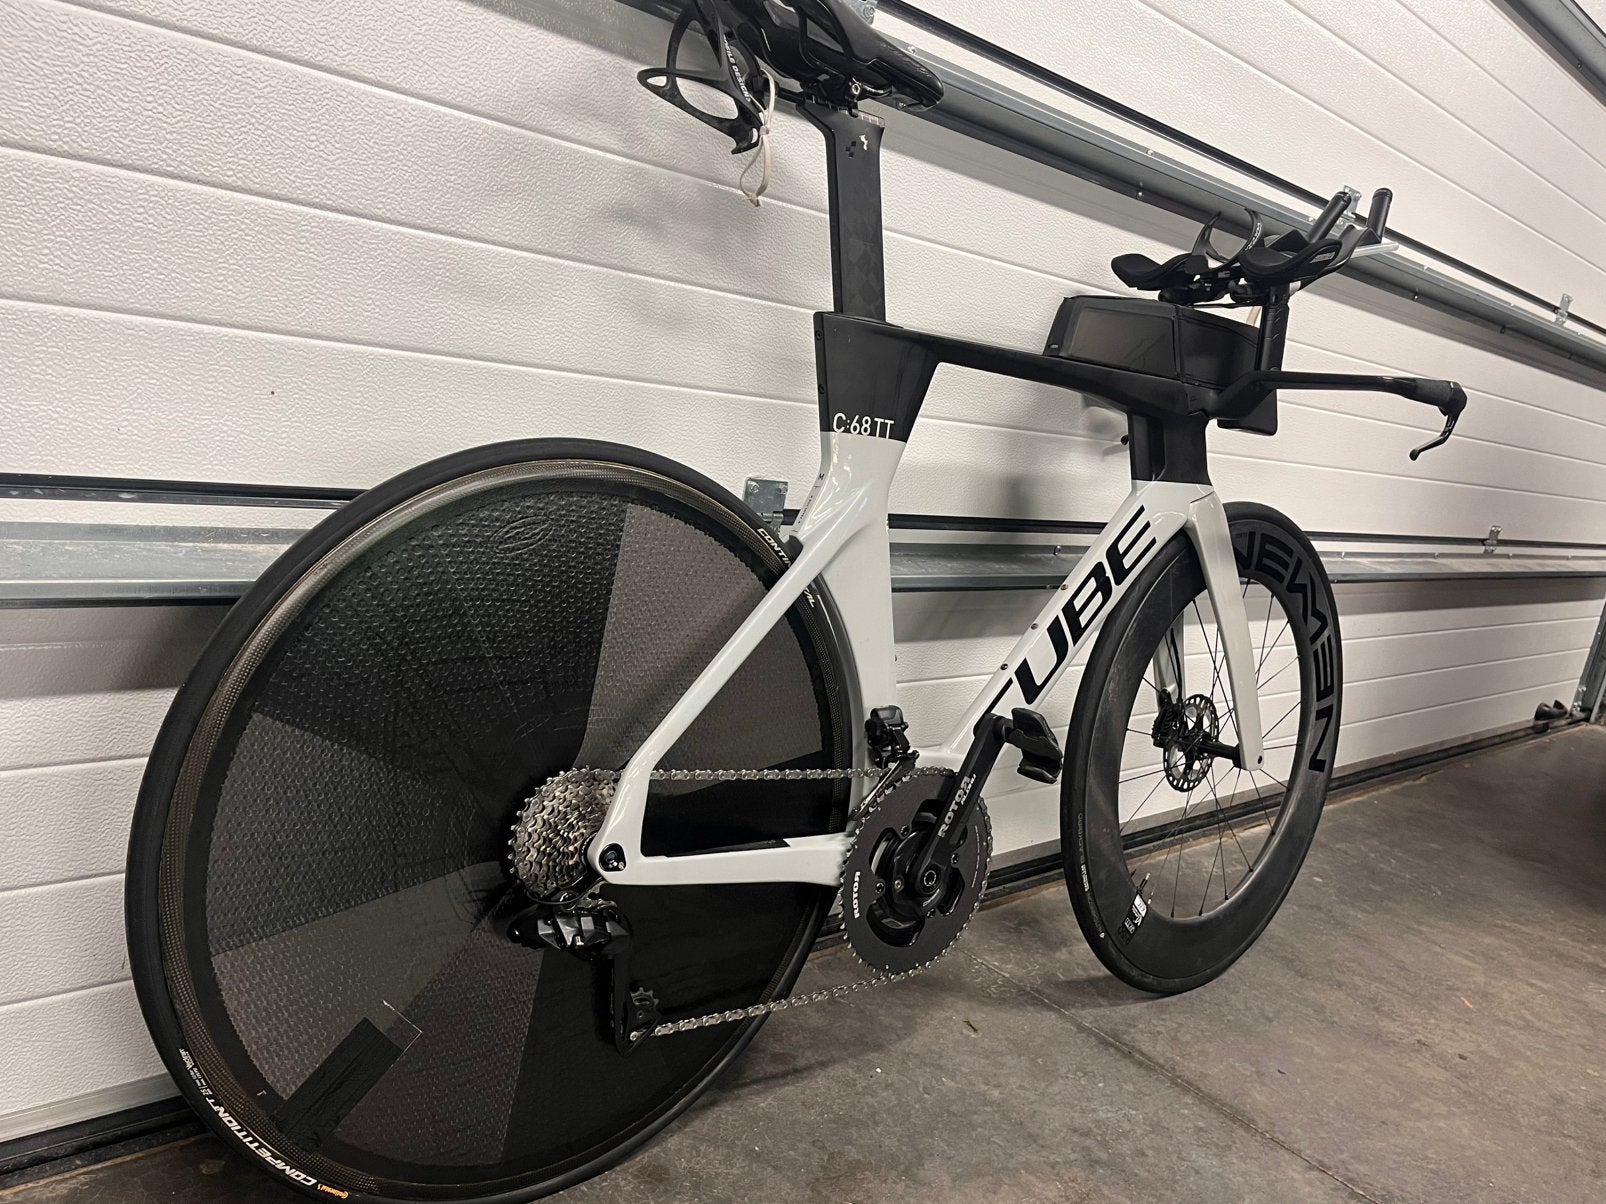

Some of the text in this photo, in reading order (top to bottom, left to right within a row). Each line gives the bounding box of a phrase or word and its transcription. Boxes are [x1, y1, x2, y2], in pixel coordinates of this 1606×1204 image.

[732, 65, 751, 98] DESIGN
[1232, 531, 1335, 773] NEWMEN
[852, 871, 861, 919] ROTOR
[215, 1106, 318, 1187] COMPETITION
